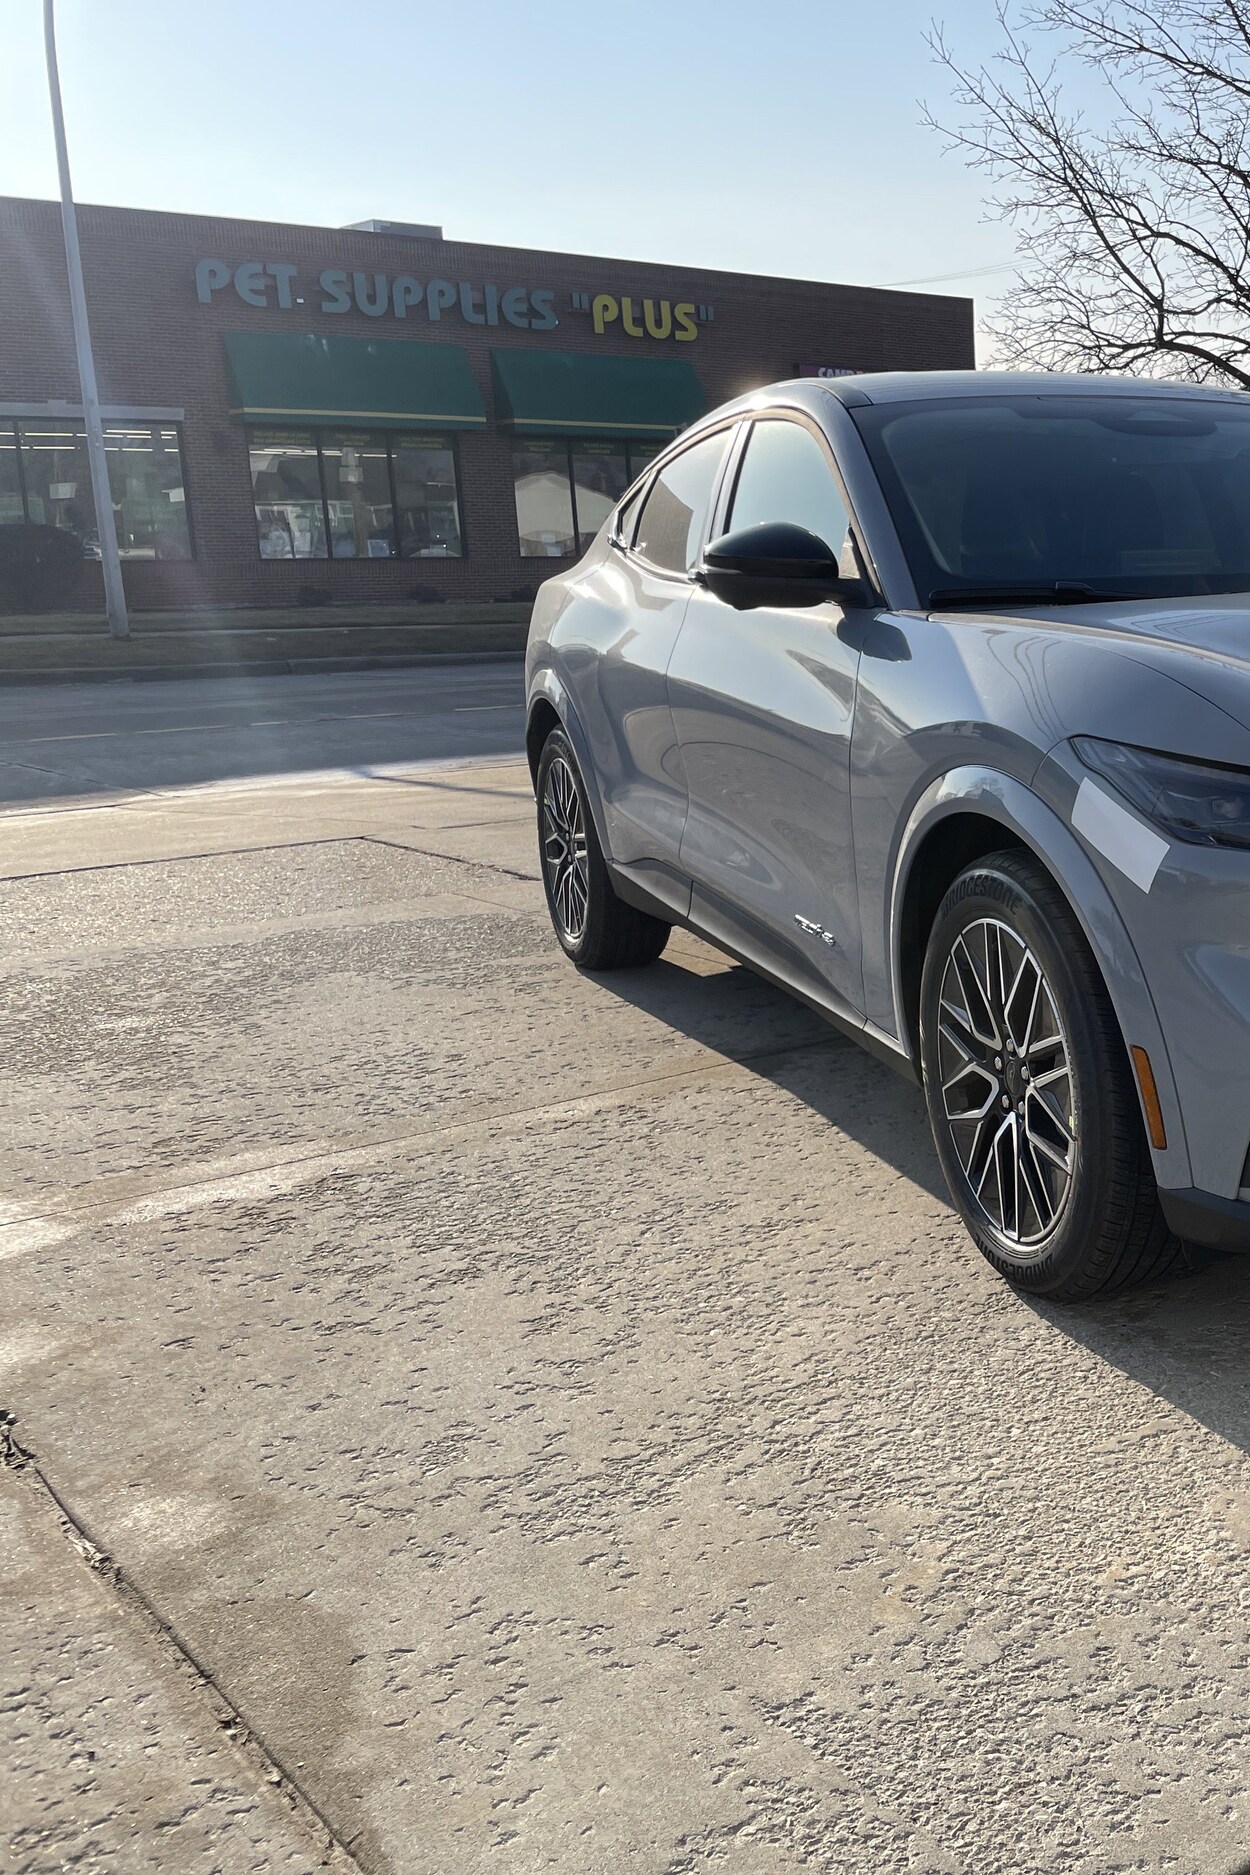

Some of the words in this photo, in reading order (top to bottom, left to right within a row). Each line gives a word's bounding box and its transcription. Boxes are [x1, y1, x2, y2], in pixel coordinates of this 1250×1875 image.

[195, 259, 298, 309] PET
[319, 269, 559, 330] SUPPLIES
[941, 873, 1021, 917] BRIDGESTONE
